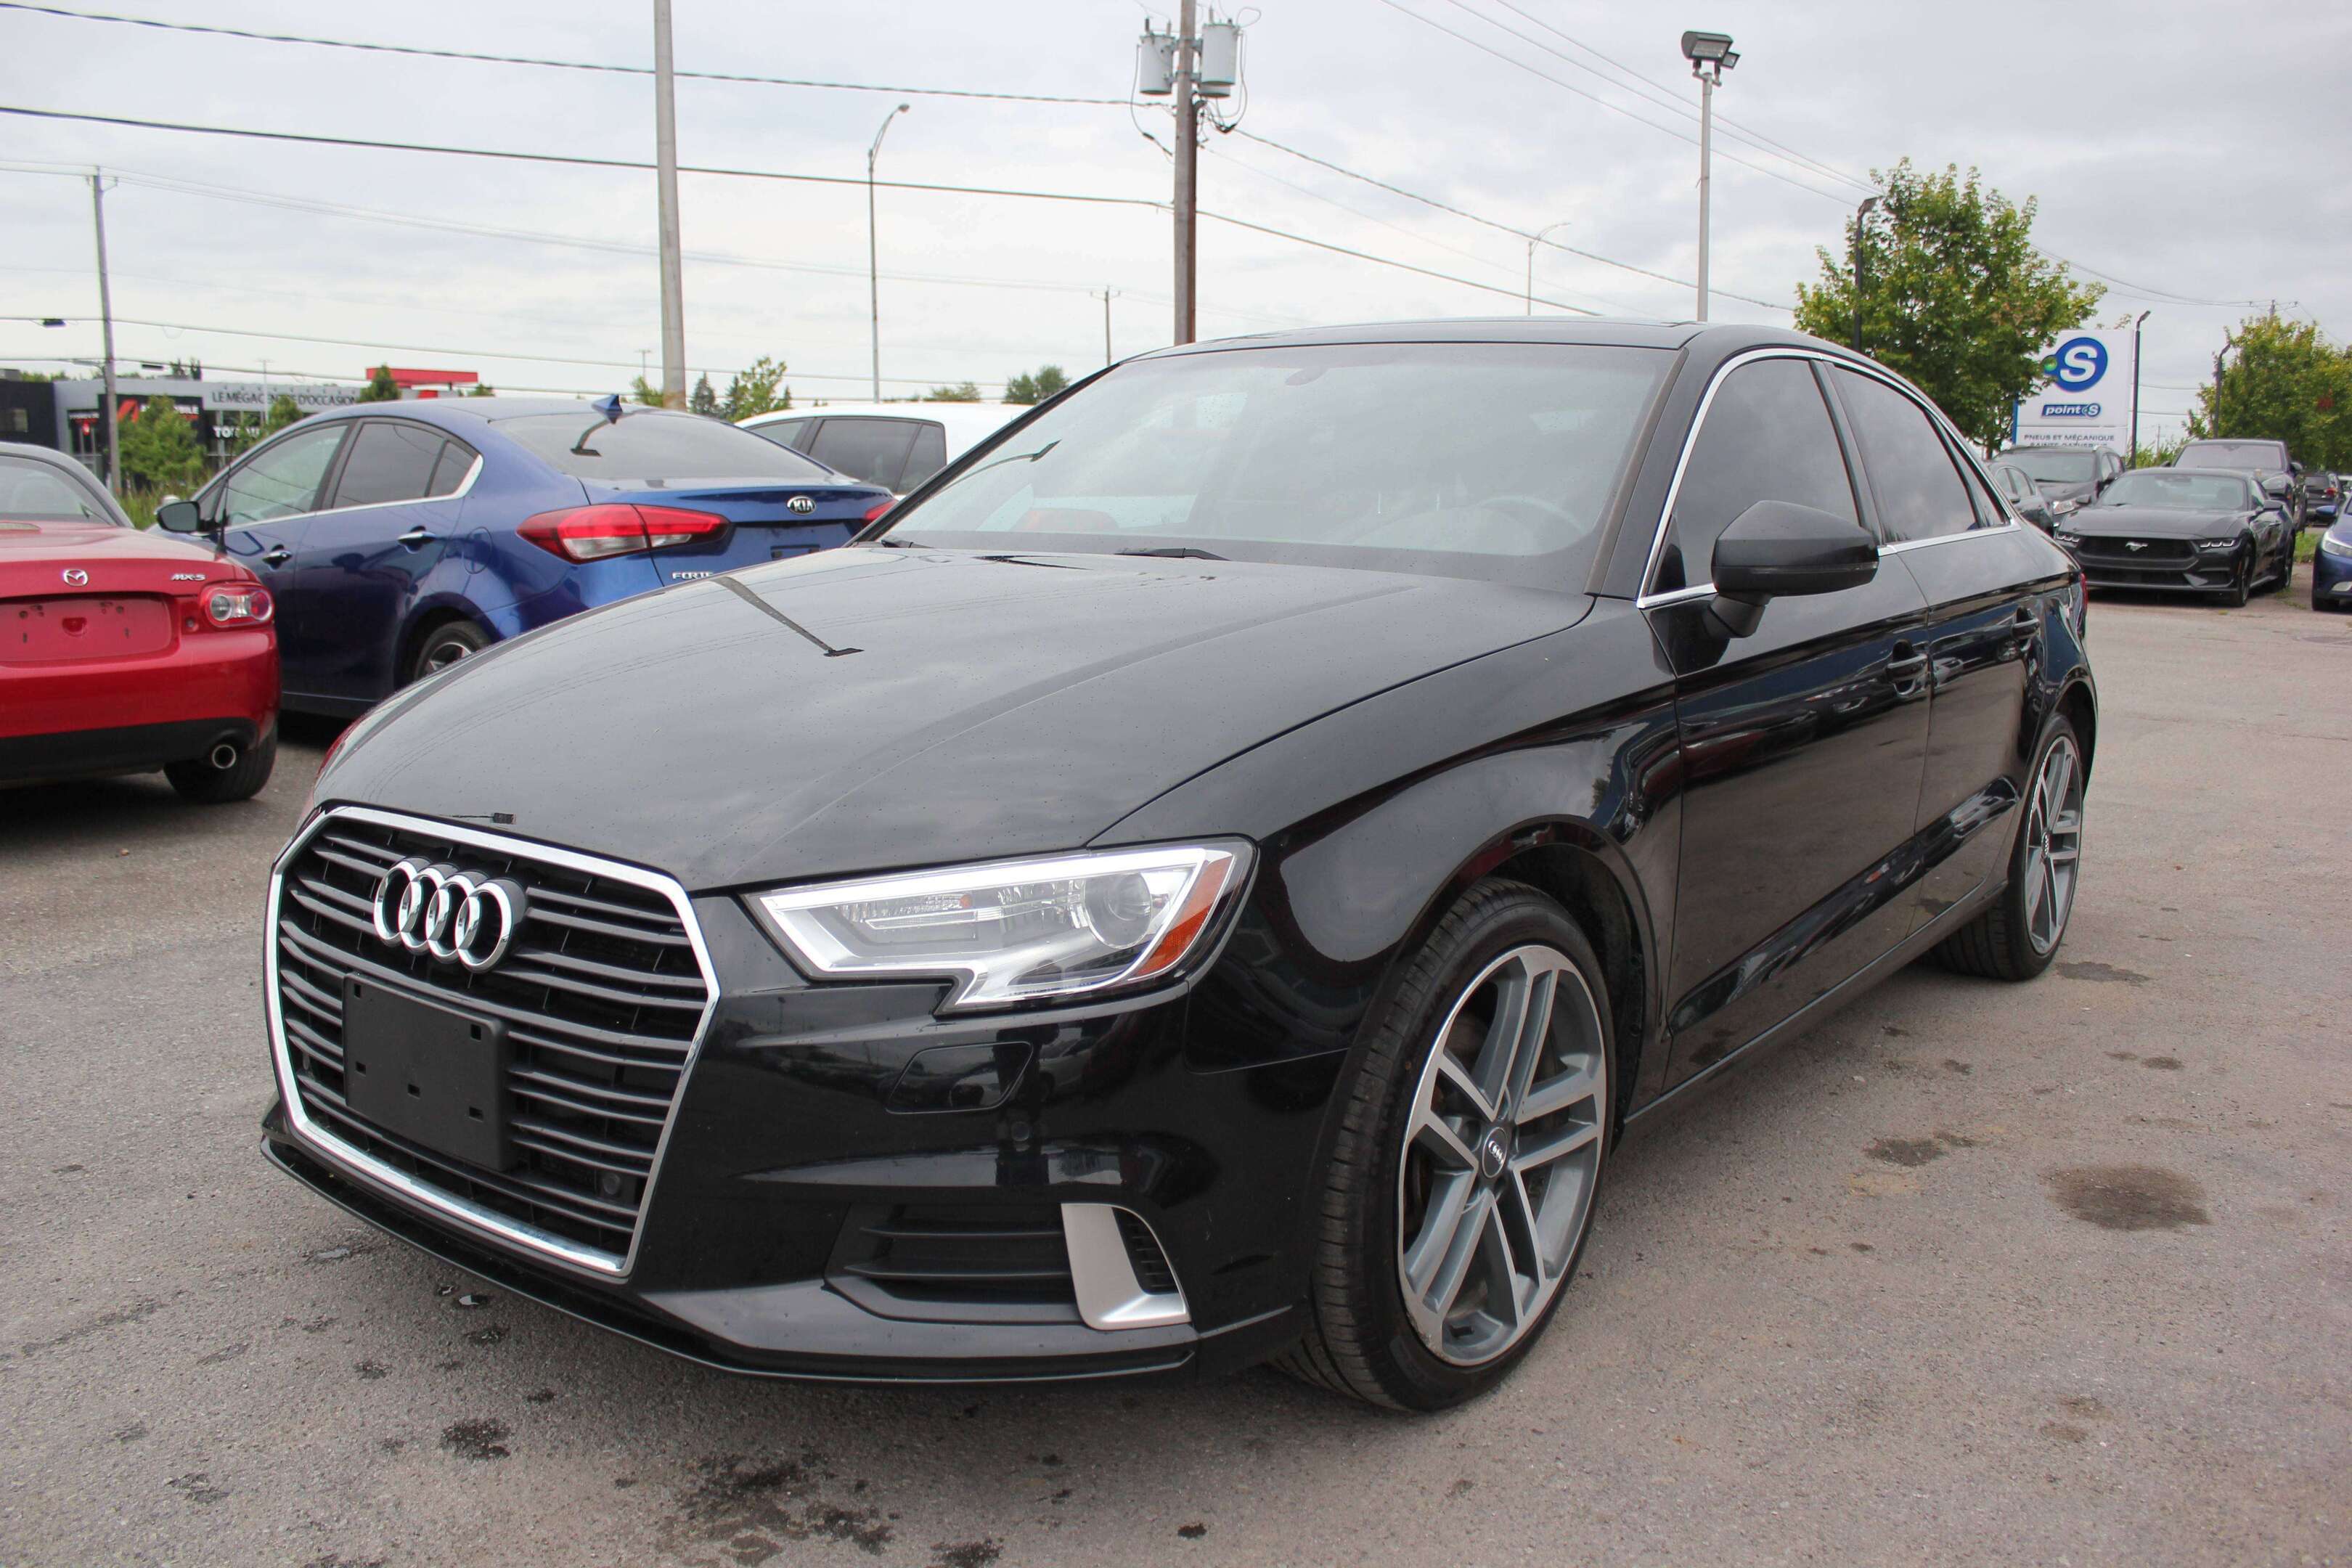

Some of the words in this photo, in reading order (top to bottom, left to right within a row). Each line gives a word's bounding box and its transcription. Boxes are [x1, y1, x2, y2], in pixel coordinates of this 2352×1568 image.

[2060, 345, 2097, 383] S
[212, 392, 224, 404] LE
[2046, 406, 2081, 416] point
[793, 499, 814, 512] KIA
